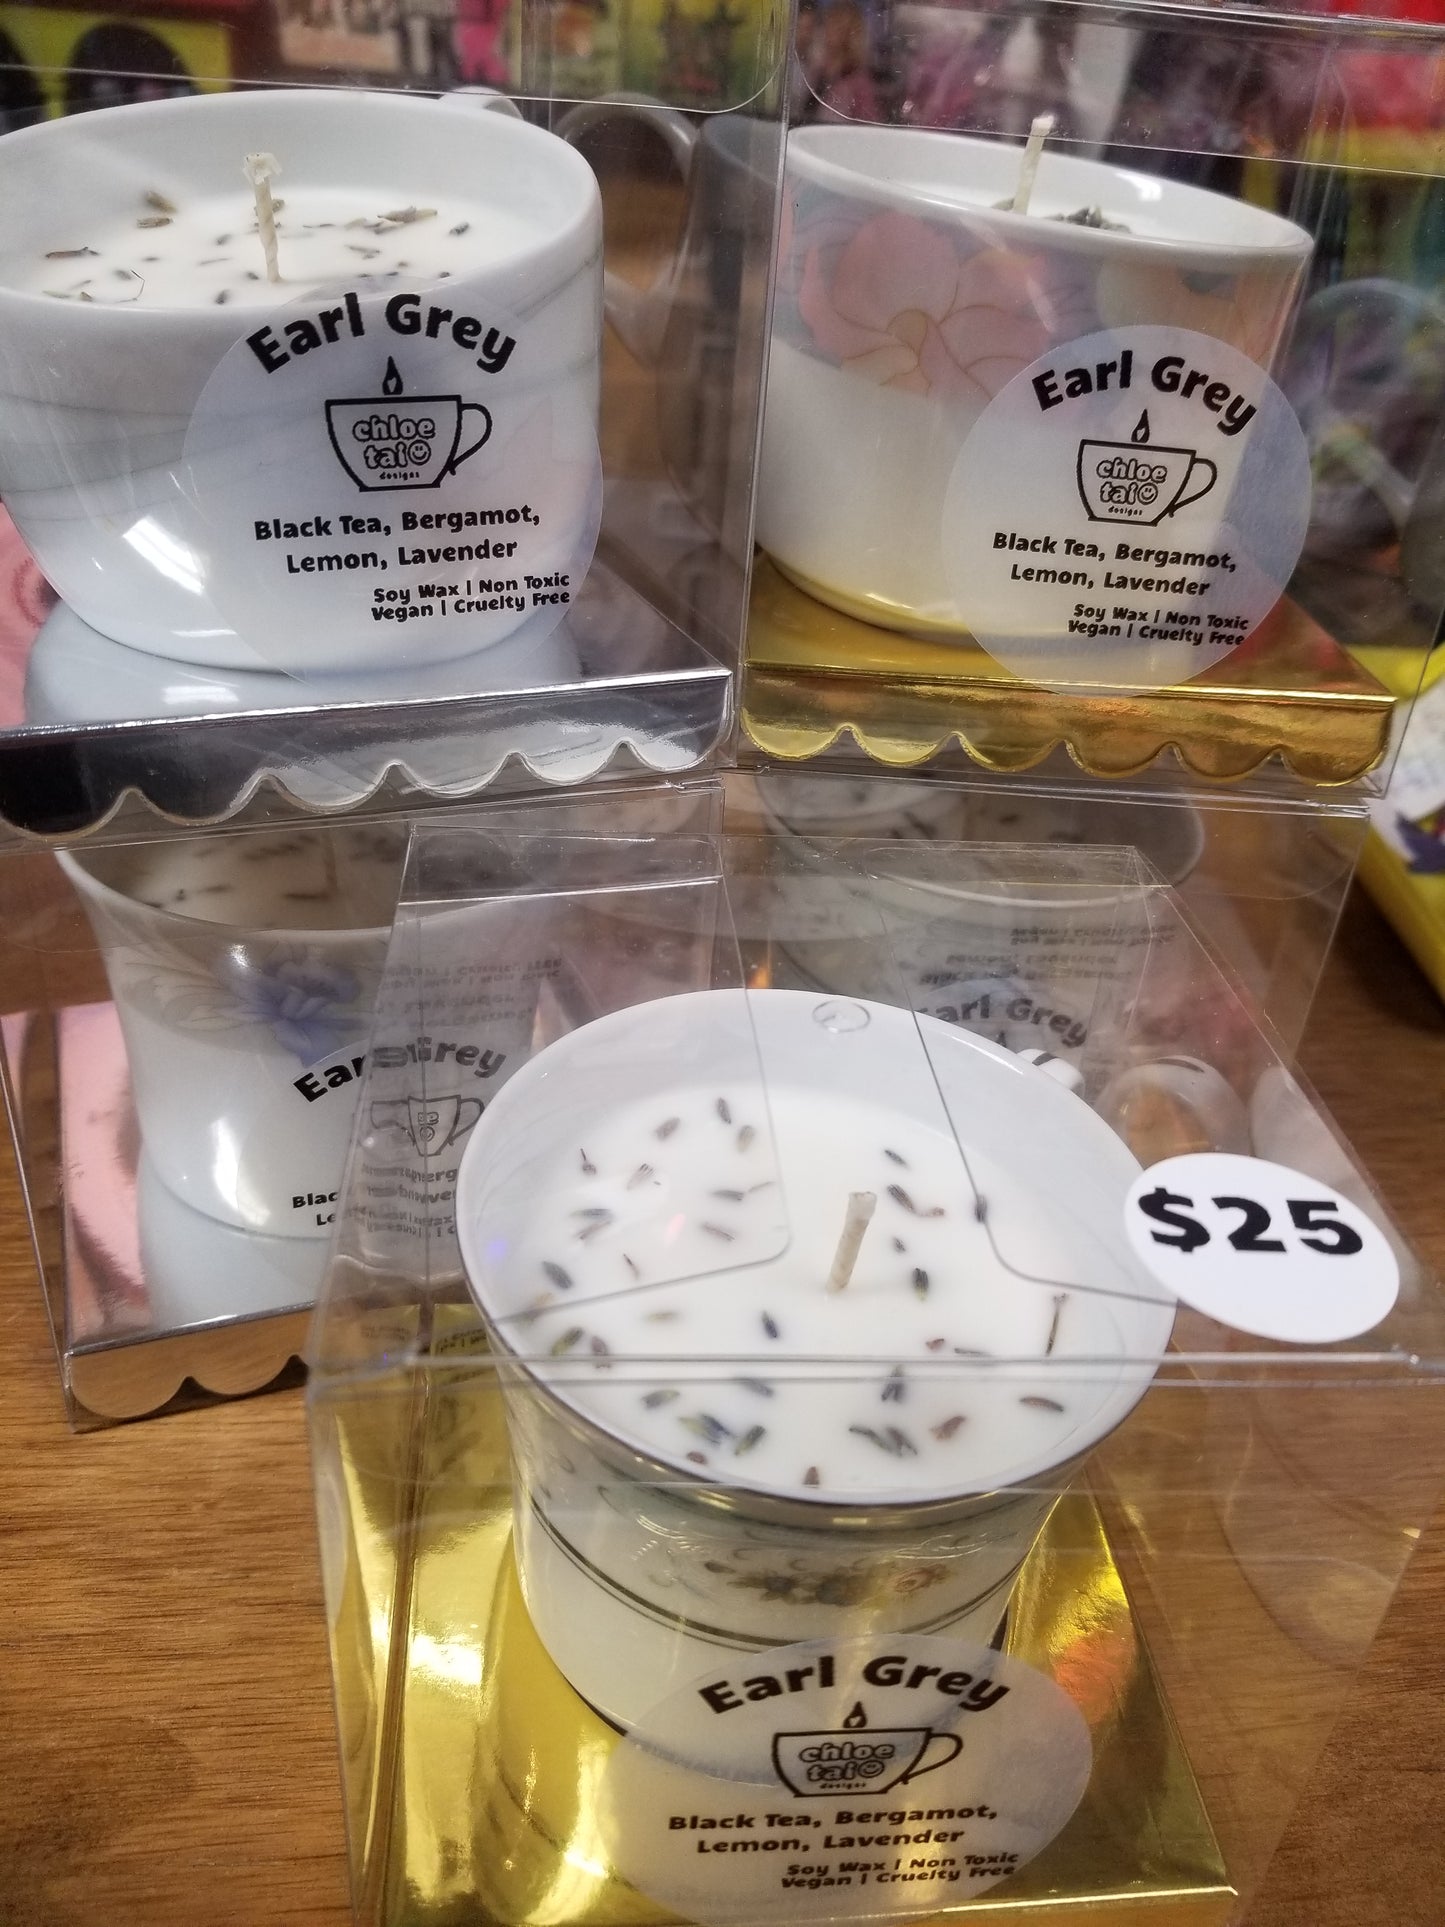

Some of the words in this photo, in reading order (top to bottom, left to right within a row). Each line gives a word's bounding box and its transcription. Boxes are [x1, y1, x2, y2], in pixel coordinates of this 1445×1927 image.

[246, 292, 365, 374] Earl
[385, 293, 517, 374] Grey
[1031, 349, 1134, 412] Earl
[1150, 356, 1257, 436] Grey
[352, 413, 436, 442] chloe
[1096, 456, 1168, 484] chloe
[254, 516, 332, 541] Black
[339, 515, 392, 537] Tea,
[401, 504, 540, 534] Bergamot,
[286, 551, 387, 574] Lemon,
[397, 538, 518, 566] Lavender
[992, 532, 1056, 555] Black
[1063, 538, 1106, 562] Tea,
[1114, 543, 1236, 573] Bergamot,
[373, 588, 411, 605] Soy
[417, 584, 460, 599] Wax
[479, 578, 518, 593] Non
[523, 572, 570, 590] Toxic
[1010, 563, 1094, 590] Lemon,
[1103, 571, 1210, 597] Lavender
[371, 604, 434, 623] Vegan
[453, 595, 526, 614] Cruelty
[532, 591, 570, 606] Free
[1073, 603, 1106, 623] Soy
[1112, 606, 1149, 622] Wax
[1165, 611, 1200, 626] Non
[1207, 614, 1249, 631] Toxic
[1068, 620, 1121, 638] Vegan
[1138, 625, 1203, 647] Cruelty
[1208, 631, 1245, 646] Free
[1006, 998, 1088, 1049] Grey
[292, 1191, 340, 1209] Blac
[1138, 1186, 1364, 1256] $25
[698, 1655, 836, 1714] Earl
[861, 1655, 1011, 1712] Grey
[799, 1741, 895, 1763] chloe
[668, 1813, 756, 1831] Black
[765, 1812, 822, 1830] Tea,
[835, 1803, 998, 1827] Bergamot,
[697, 1835, 810, 1854] Lemon,
[822, 1828, 965, 1850] Lavender
[781, 1875, 852, 1890] Vegan
[875, 1868, 961, 1884] Cruelty
[968, 1864, 1016, 1878] Free
[787, 1864, 830, 1877] Soy
[838, 1860, 887, 1873] Wax
[908, 1857, 956, 1869] Non
[963, 1852, 1020, 1866] Toxic
